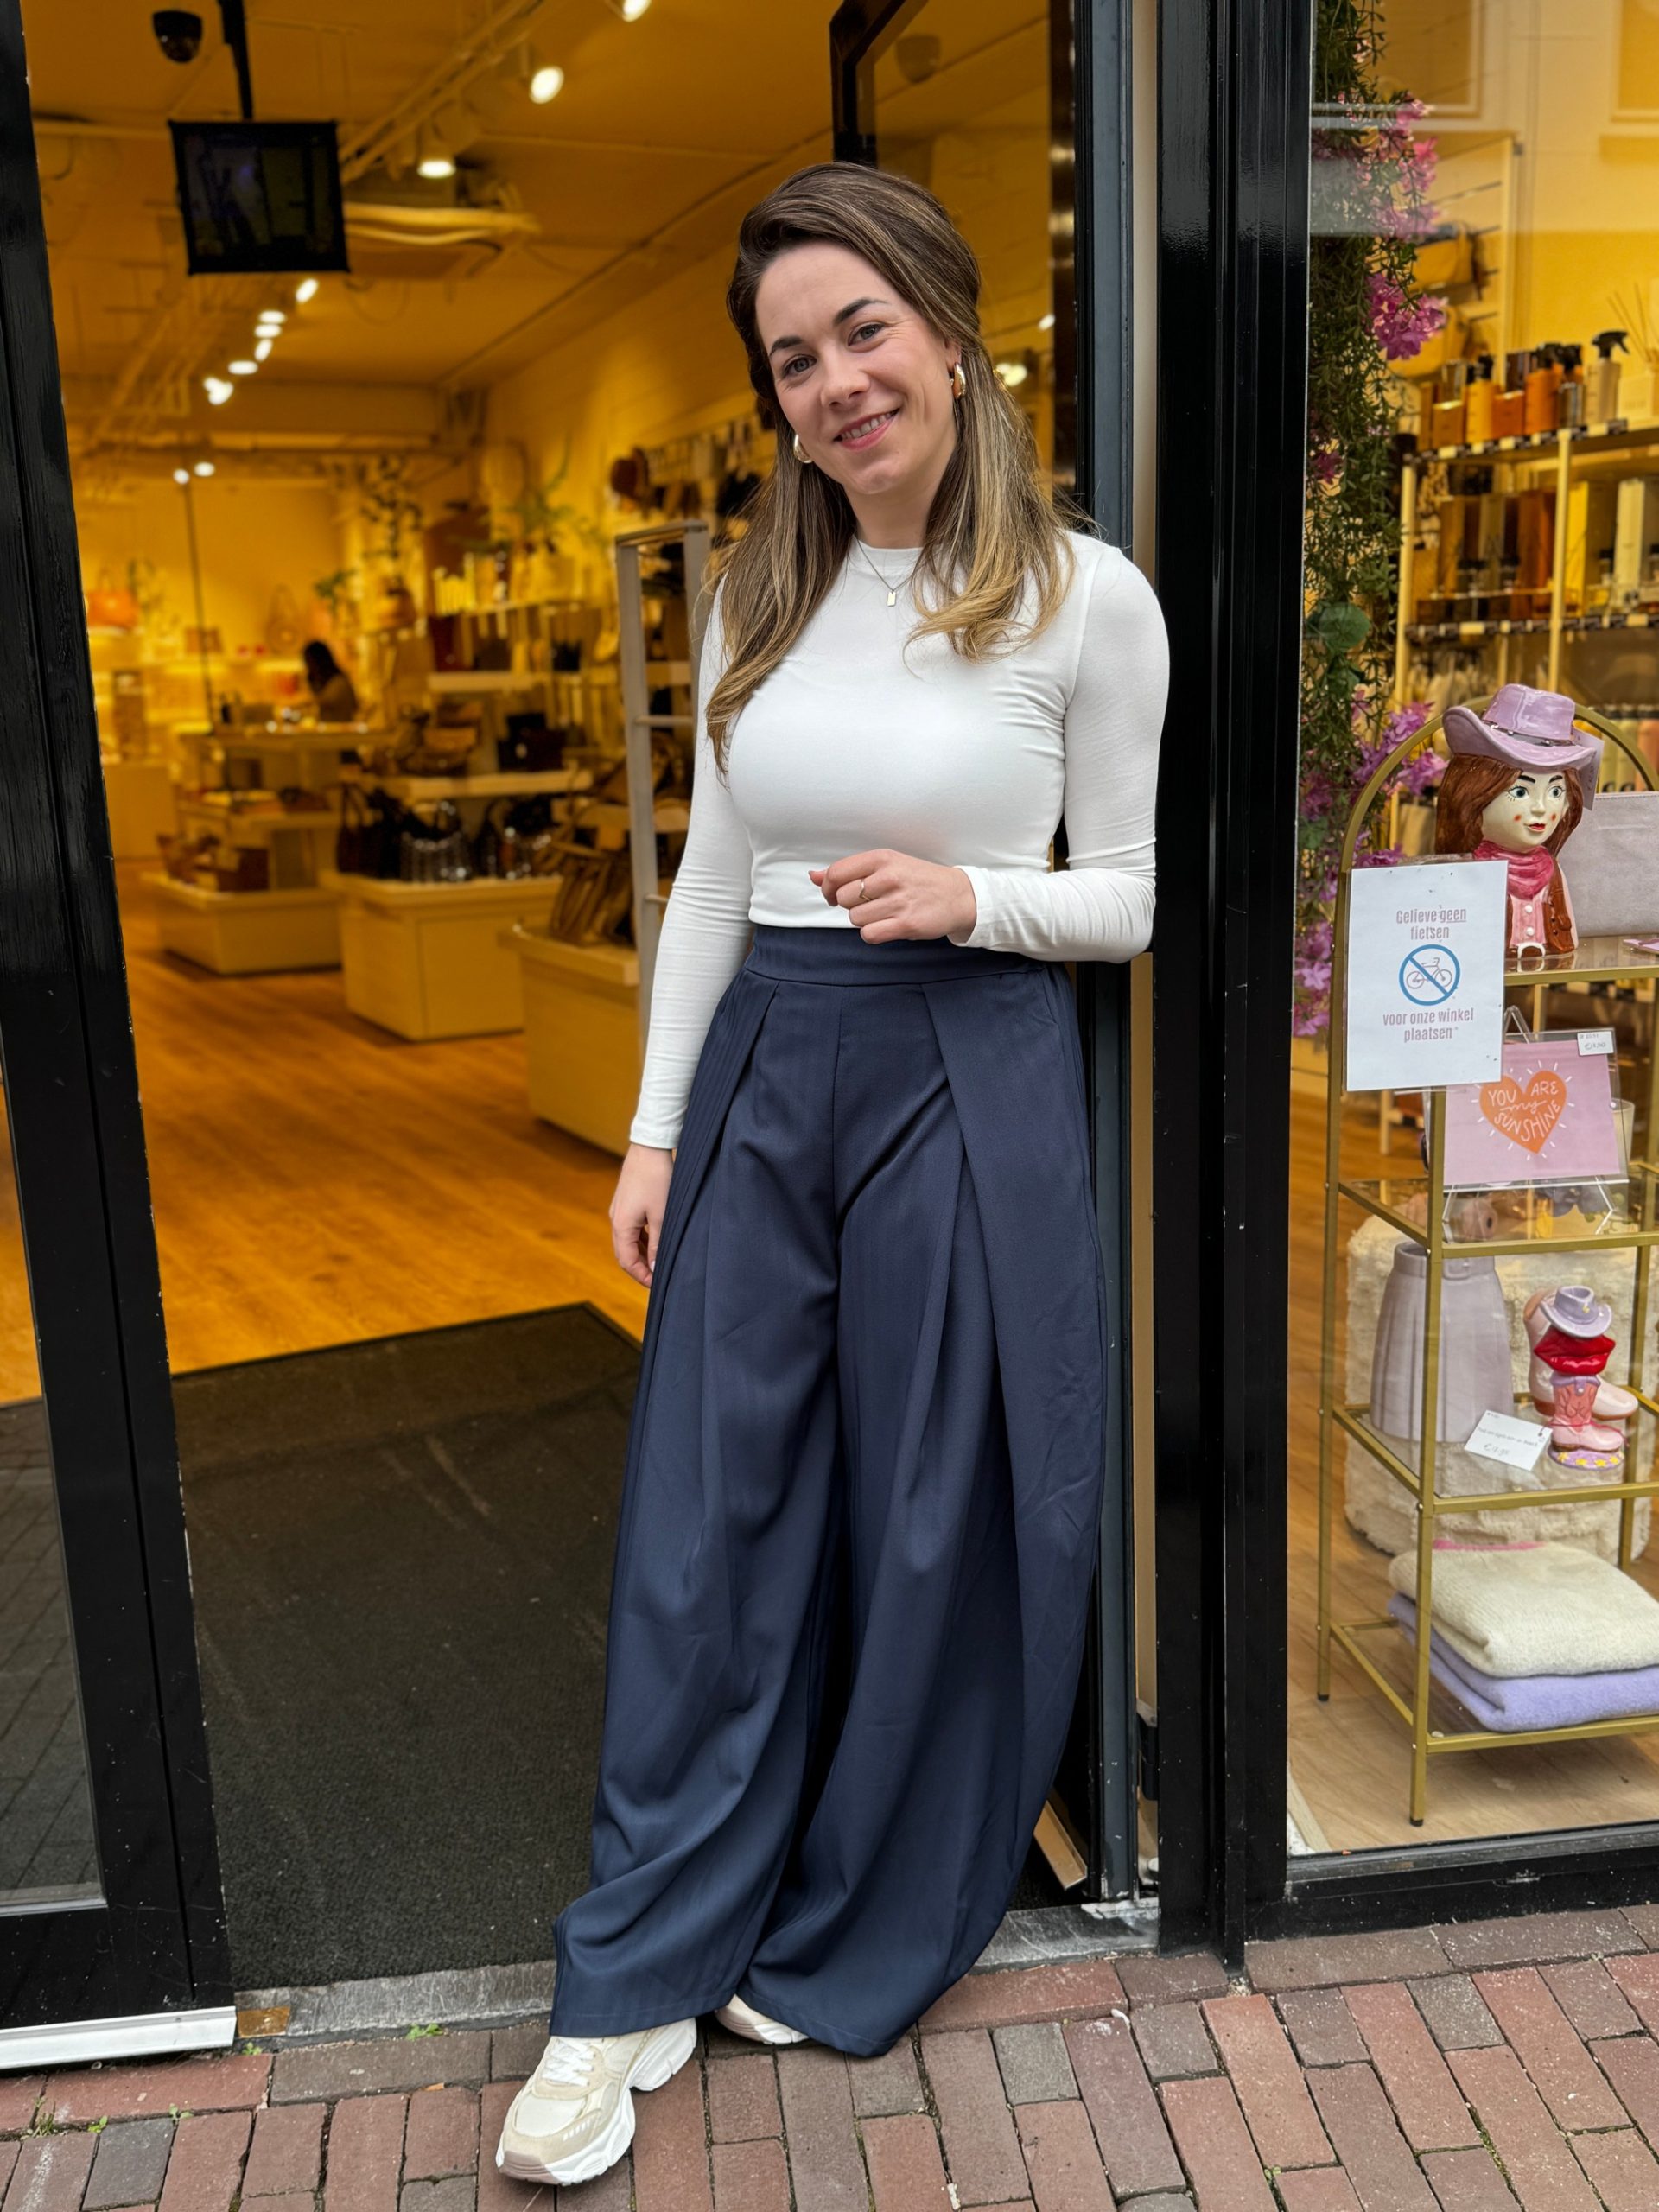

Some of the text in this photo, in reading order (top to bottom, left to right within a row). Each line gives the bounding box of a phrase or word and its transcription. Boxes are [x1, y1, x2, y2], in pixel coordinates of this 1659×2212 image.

[1396, 908, 1467, 924] Gelieve geen
[1410, 925, 1450, 940] fietsen
[1382, 1007, 1474, 1027] voor onze winkel
[1403, 1026, 1452, 1043] plaatsen
[1487, 1080, 1559, 1107] YOU ARE
[1499, 1099, 1548, 1115] my
[1493, 1099, 1560, 1142] SUNSHINE
